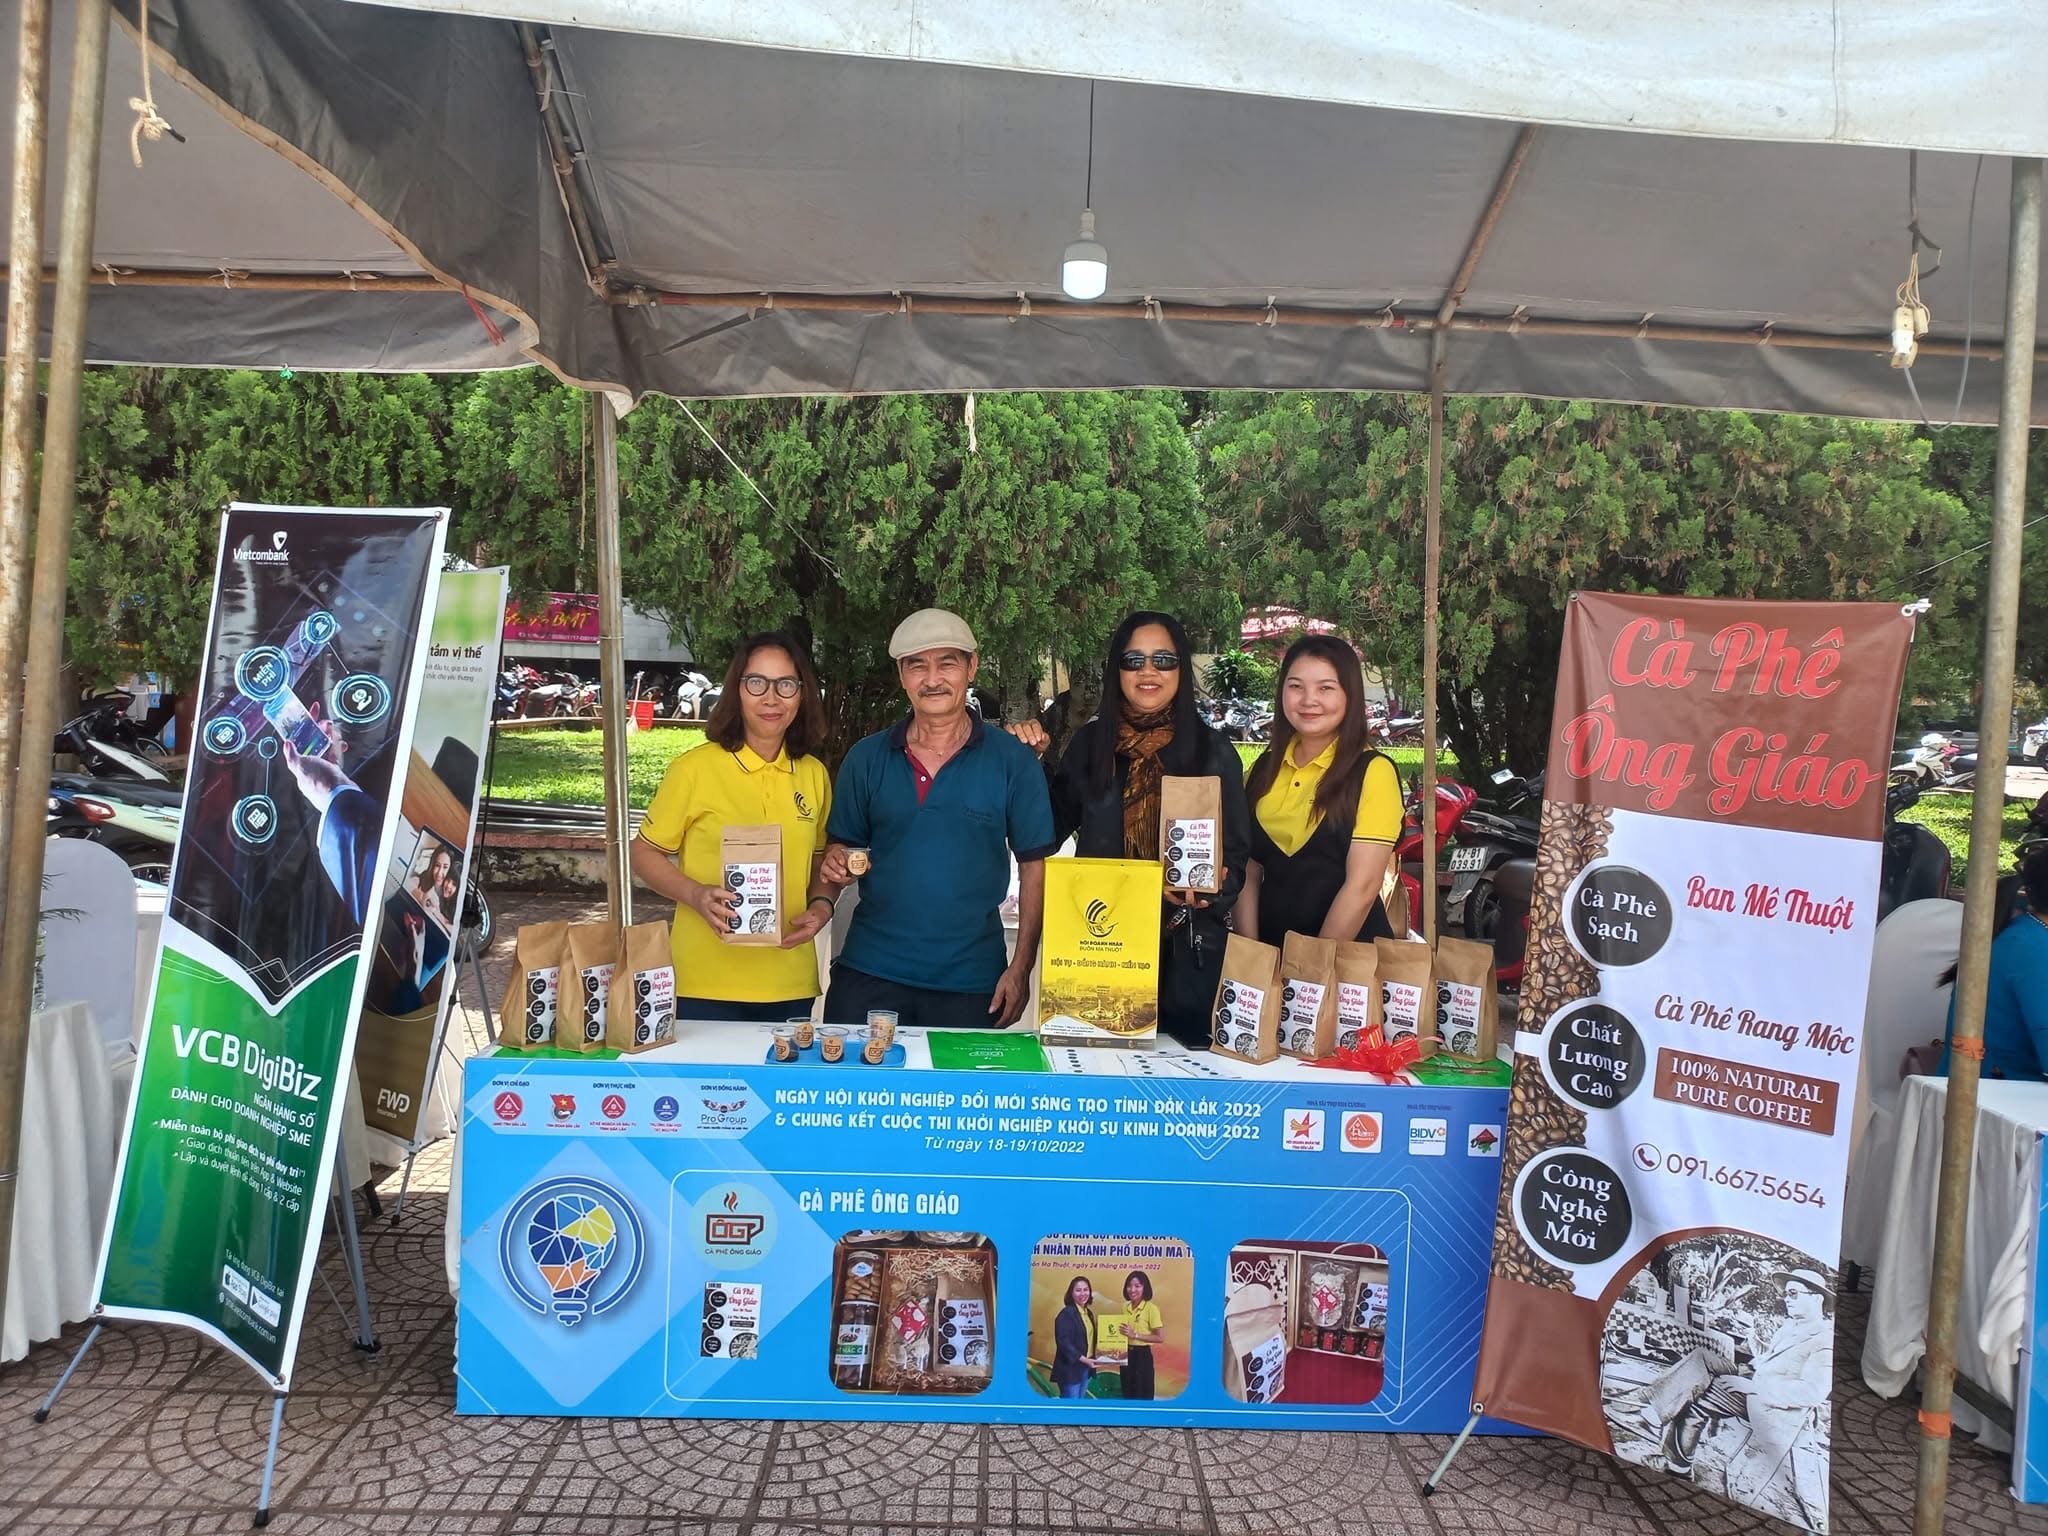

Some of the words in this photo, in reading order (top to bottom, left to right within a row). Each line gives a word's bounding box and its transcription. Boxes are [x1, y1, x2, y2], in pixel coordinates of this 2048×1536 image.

[233, 548, 289, 561] Vietcombank
[452, 647, 462, 660] vị
[464, 645, 484, 659] thế
[1607, 616, 1698, 689] Cà
[1709, 621, 1845, 699] Phê
[1560, 693, 1696, 811] Ông
[1708, 726, 1884, 815] Giáo
[1580, 887, 1604, 908] Cà
[1611, 892, 1657, 918] Phê
[1687, 875, 1736, 912] Ban
[1742, 883, 1780, 918] Mê
[1785, 889, 1854, 934] Thuột
[1588, 916, 1639, 943] Sạch
[1571, 1018, 1622, 1045] Chất
[1654, 994, 1685, 1022] Cà
[1690, 1000, 1734, 1030] Phê
[1737, 1009, 1799, 1051] Rang
[1805, 1022, 1855, 1057] Mộc
[172, 1024, 241, 1068] VCB
[243, 1040, 322, 1101] DigiBiz
[1557, 1042, 1629, 1081] Lượng
[1570, 1073, 1613, 1099] Cao
[1671, 1057, 1719, 1082] 100%
[1724, 1068, 1824, 1104] NATURAL
[171, 1086, 208, 1104] DÀNH
[211, 1095, 232, 1110] CHO
[234, 1102, 260, 1123] DOANH
[261, 1115, 287, 1137] NGHIỆP
[288, 1130, 312, 1147] SME
[254, 1092, 273, 1114] NGÂN
[273, 1103, 297, 1123] HÀNG
[299, 1112, 317, 1129] SỐ
[377, 1087, 410, 1113] FWD
[775, 1088, 819, 1104] NGÀY
[825, 1088, 852, 1108] HỘI
[858, 1088, 895, 1106] KHỞI
[900, 1091, 955, 1111] NGHIỆP
[961, 1089, 988, 1108] ĐỔI
[994, 1093, 1025, 1110] MỚI
[1031, 1094, 1071, 1111] SÁNG
[1077, 1098, 1108, 1115] TẠO
[1114, 1095, 1147, 1113] TỈNH
[1154, 1095, 1184, 1115] ĐẮK
[1190, 1096, 1217, 1116] LẮK
[1223, 1102, 1262, 1117] 2022
[1675, 1082, 1729, 1109] PURE
[1734, 1094, 1812, 1126] COFFEE
[160, 1118, 188, 1131] Miễn
[190, 1124, 211, 1136] toàn
[213, 1128, 223, 1140] bộ
[775, 1112, 786, 1126] &
[792, 1113, 843, 1127] CHUNG
[849, 1109, 876, 1128] KẾT
[881, 1112, 922, 1132] CUỘC
[928, 1116, 951, 1130] THI
[956, 1113, 993, 1131] KHỞI
[999, 1116, 1052, 1136] NGHIỆP
[1058, 1117, 1094, 1134] KHỞI
[1123, 1121, 1159, 1136] KINH
[1164, 1123, 1217, 1138] DOANH
[1223, 1125, 1260, 1139] 2022
[1410, 1128, 1436, 1138] BIDV
[924, 1136, 945, 1149] Từ
[946, 1138, 983, 1152] ngày
[987, 1138, 1085, 1153] 18-19/10/2022
[180, 1151, 197, 1164] Lập
[200, 1155, 209, 1166] và
[280, 1195, 286, 1206] 2
[286, 1198, 300, 1213] cấp
[186, 1137, 206, 1150] Giao
[208, 1142, 223, 1154] dịch
[276, 1176, 302, 1196] Website
[1543, 1163, 1612, 1202] Công
[1666, 1153, 1826, 1209] 091.667.5654
[799, 1188, 823, 1212] CÀ
[830, 1188, 865, 1213] PHÊ
[871, 1187, 910, 1214] ÔNG
[916, 1189, 960, 1215] GIÁO
[1539, 1190, 1608, 1226] Nghệ
[1043, 1243, 1070, 1255] NHÂN
[1074, 1243, 1106, 1256] THÀNH
[1110, 1243, 1130, 1256] PHỐ
[1133, 1244, 1162, 1257] BUÔN
[1166, 1247, 1183, 1257] MA
[1544, 1220, 1596, 1250] Mới
